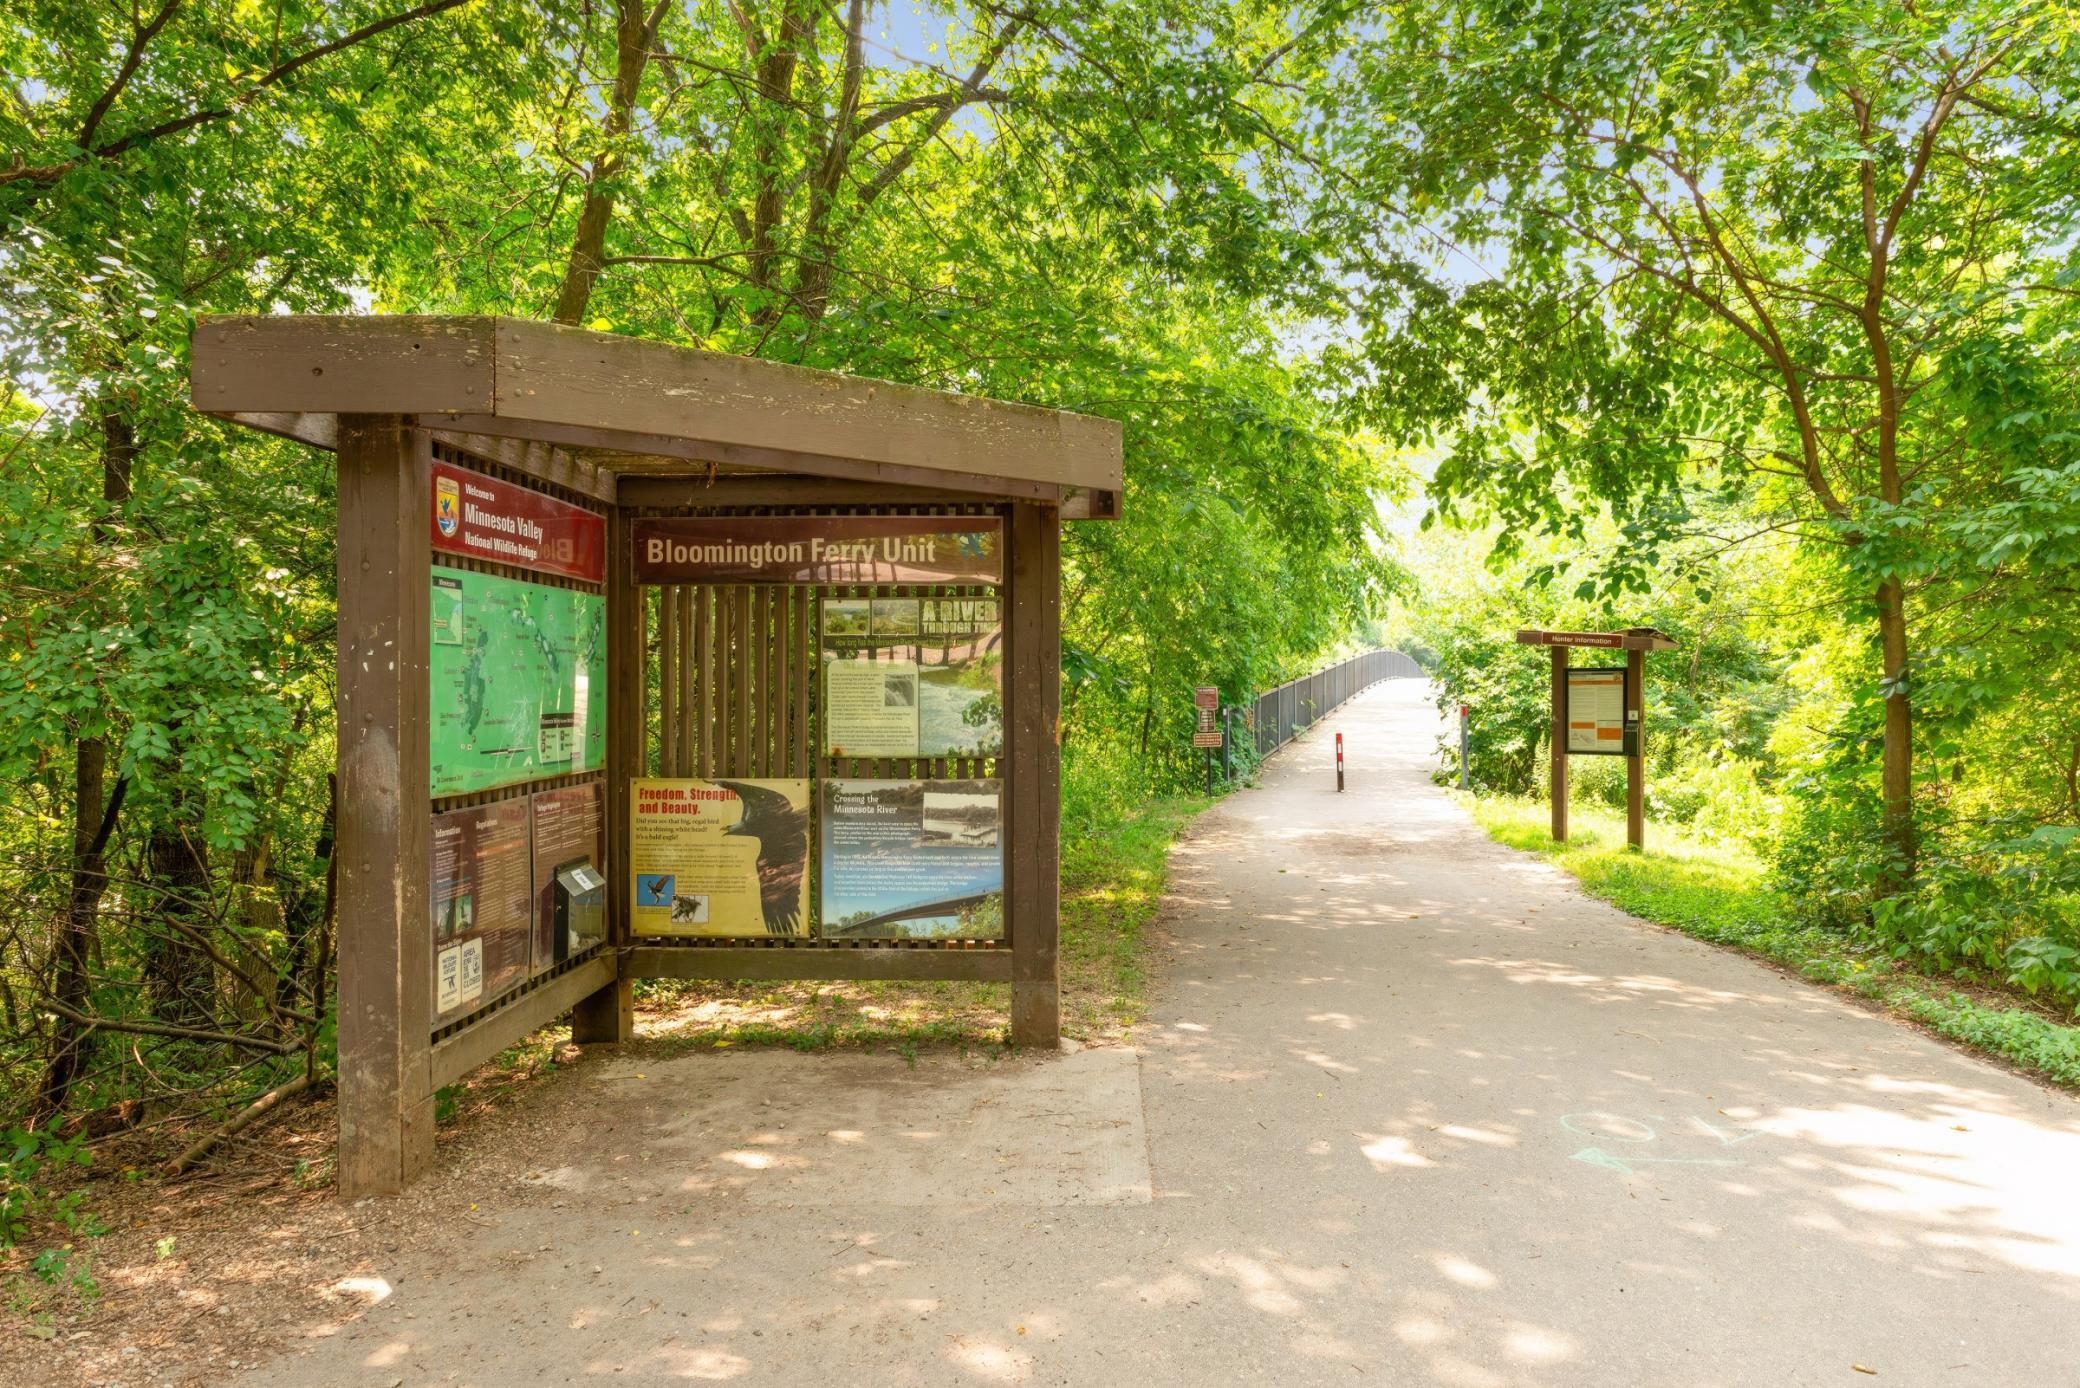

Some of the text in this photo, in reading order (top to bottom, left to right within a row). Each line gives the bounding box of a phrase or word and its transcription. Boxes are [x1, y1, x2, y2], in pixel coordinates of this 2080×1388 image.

[465, 483, 489, 500] Welcome
[489, 492, 495, 502] to
[465, 502, 543, 544] Minnesota Valley
[464, 531, 537, 560] National Wildlife Refuge
[647, 537, 936, 568] Bloomington Ferry Unit
[922, 601, 998, 621] A RIVER
[922, 622, 971, 634] THROUGH
[639, 788, 687, 801] Freedom,
[833, 795, 879, 804] Crossing the
[639, 802, 701, 815] and Beauty.
[833, 804, 898, 814] Minnesota River
